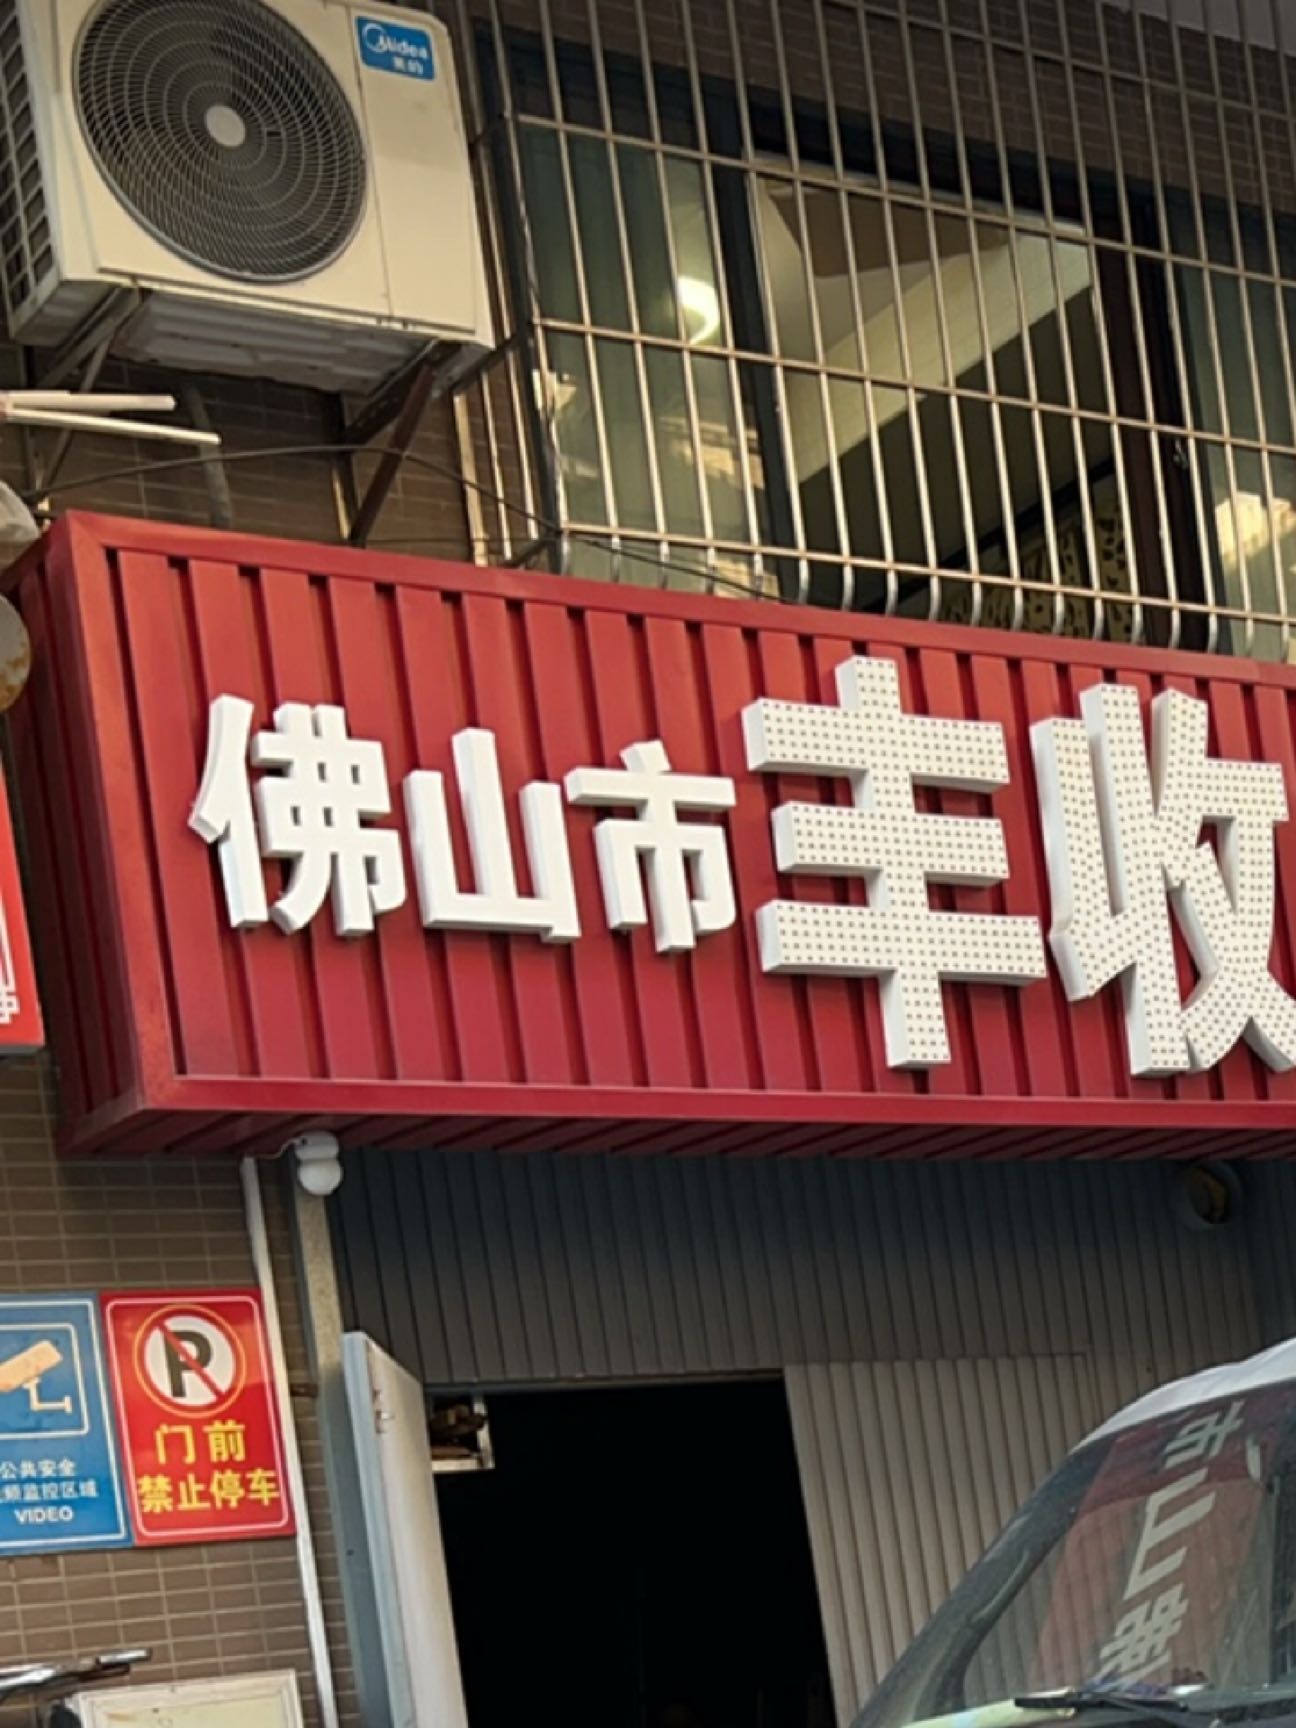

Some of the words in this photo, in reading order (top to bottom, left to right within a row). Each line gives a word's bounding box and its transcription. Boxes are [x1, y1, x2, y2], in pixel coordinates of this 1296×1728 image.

[155, 1419, 246, 1465] 门前
[0, 1479, 99, 1503] 频监控区域
[138, 1468, 280, 1514] 禁止停车
[14, 1506, 74, 1524] VIDEO
